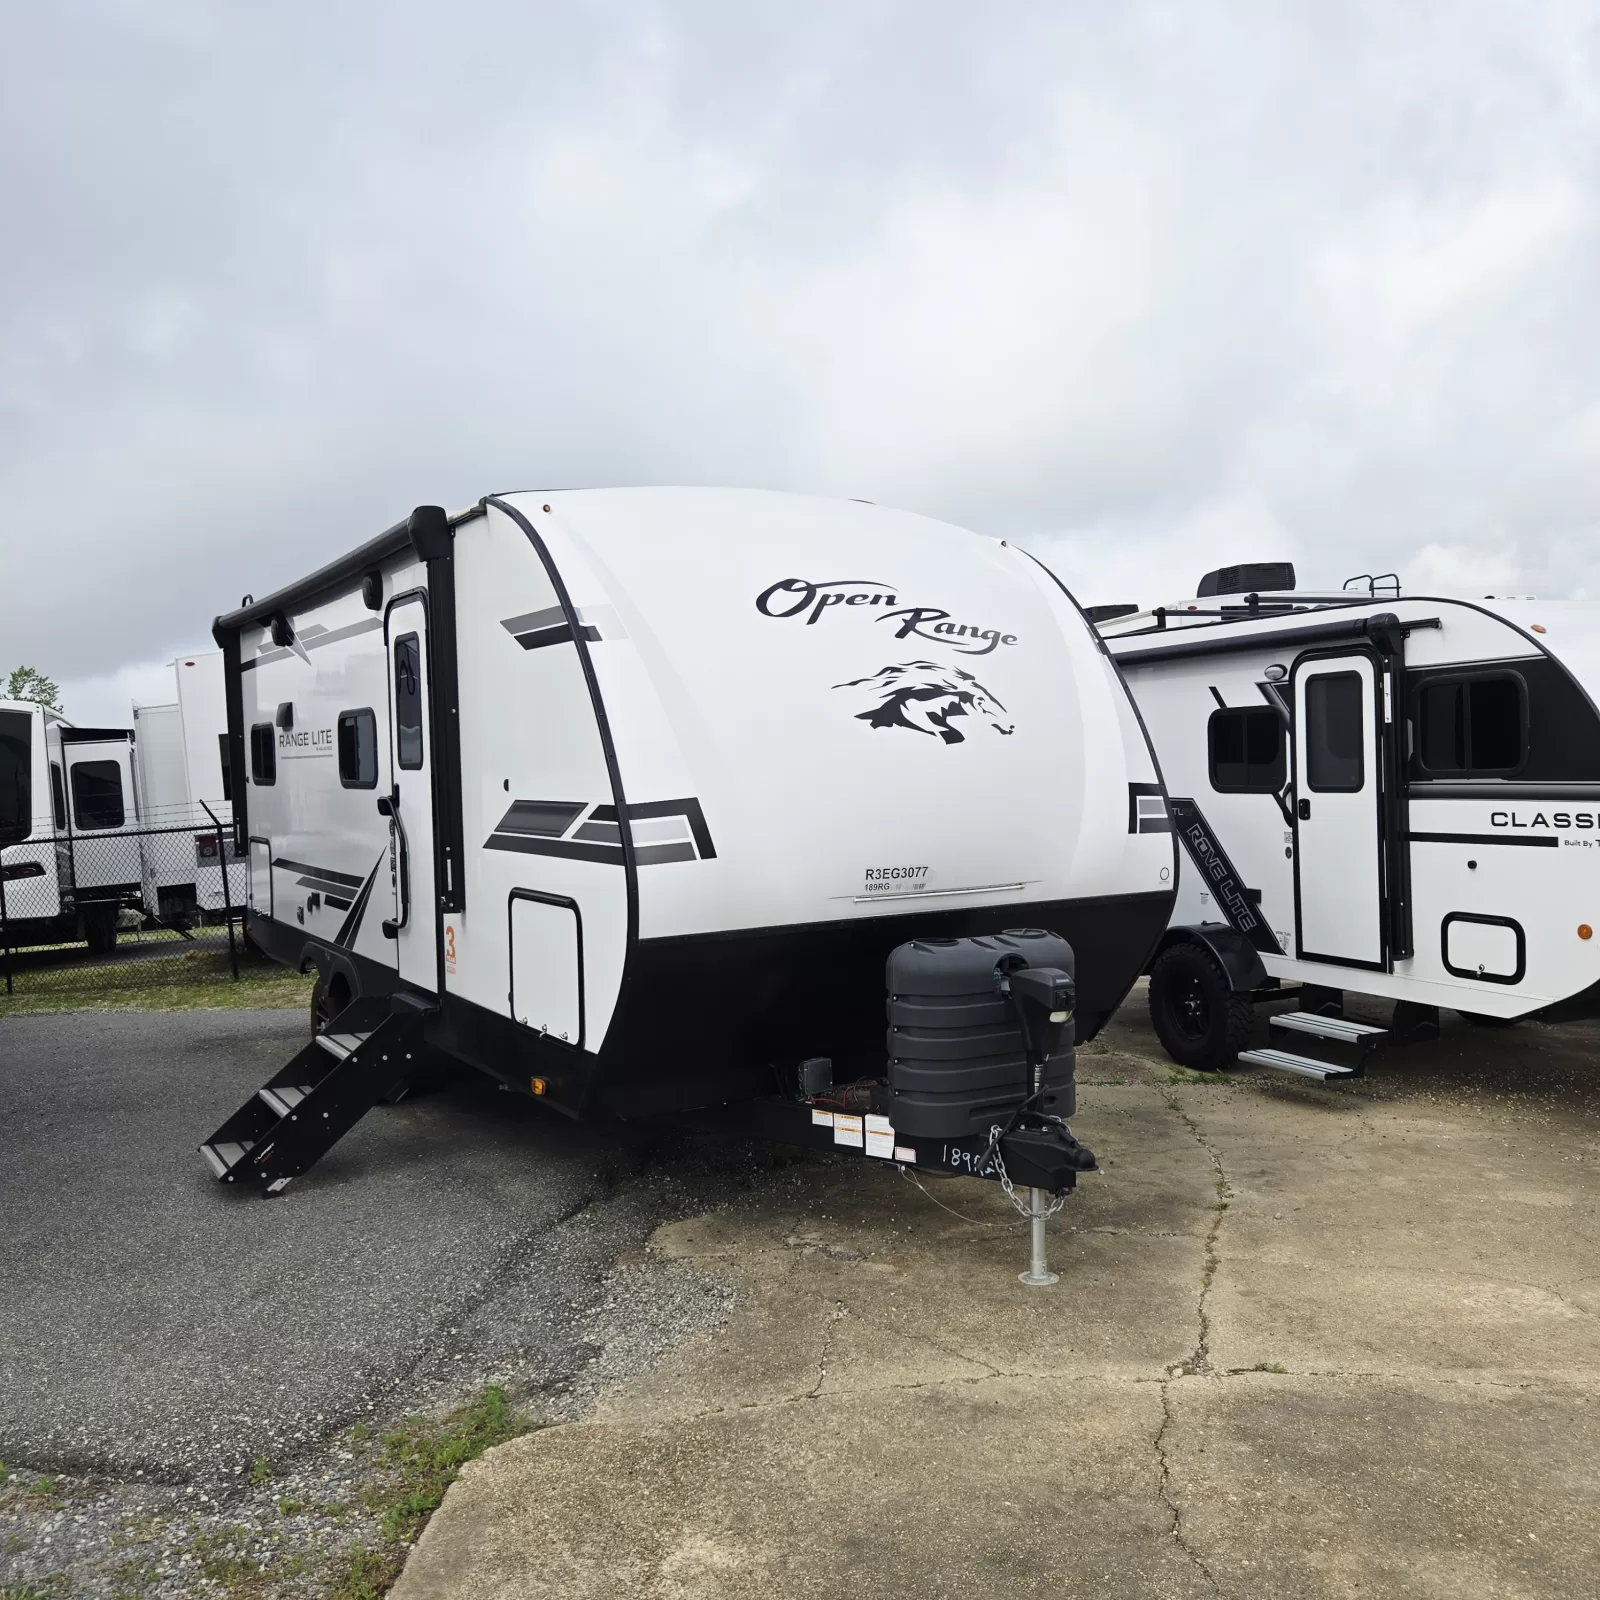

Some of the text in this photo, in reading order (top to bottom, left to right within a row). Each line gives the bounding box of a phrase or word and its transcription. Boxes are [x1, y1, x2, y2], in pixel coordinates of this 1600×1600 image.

[756, 578, 899, 625] Open
[875, 607, 1019, 655] Range
[279, 729, 332, 747] RANGE LITE
[1564, 839, 1581, 847] Built
[1582, 840, 1593, 848] By
[865, 866, 929, 880] R3EG3077
[1186, 823, 1257, 932] ROVE LITE
[864, 882, 890, 891] 189RG
[446, 925, 456, 958] 3
